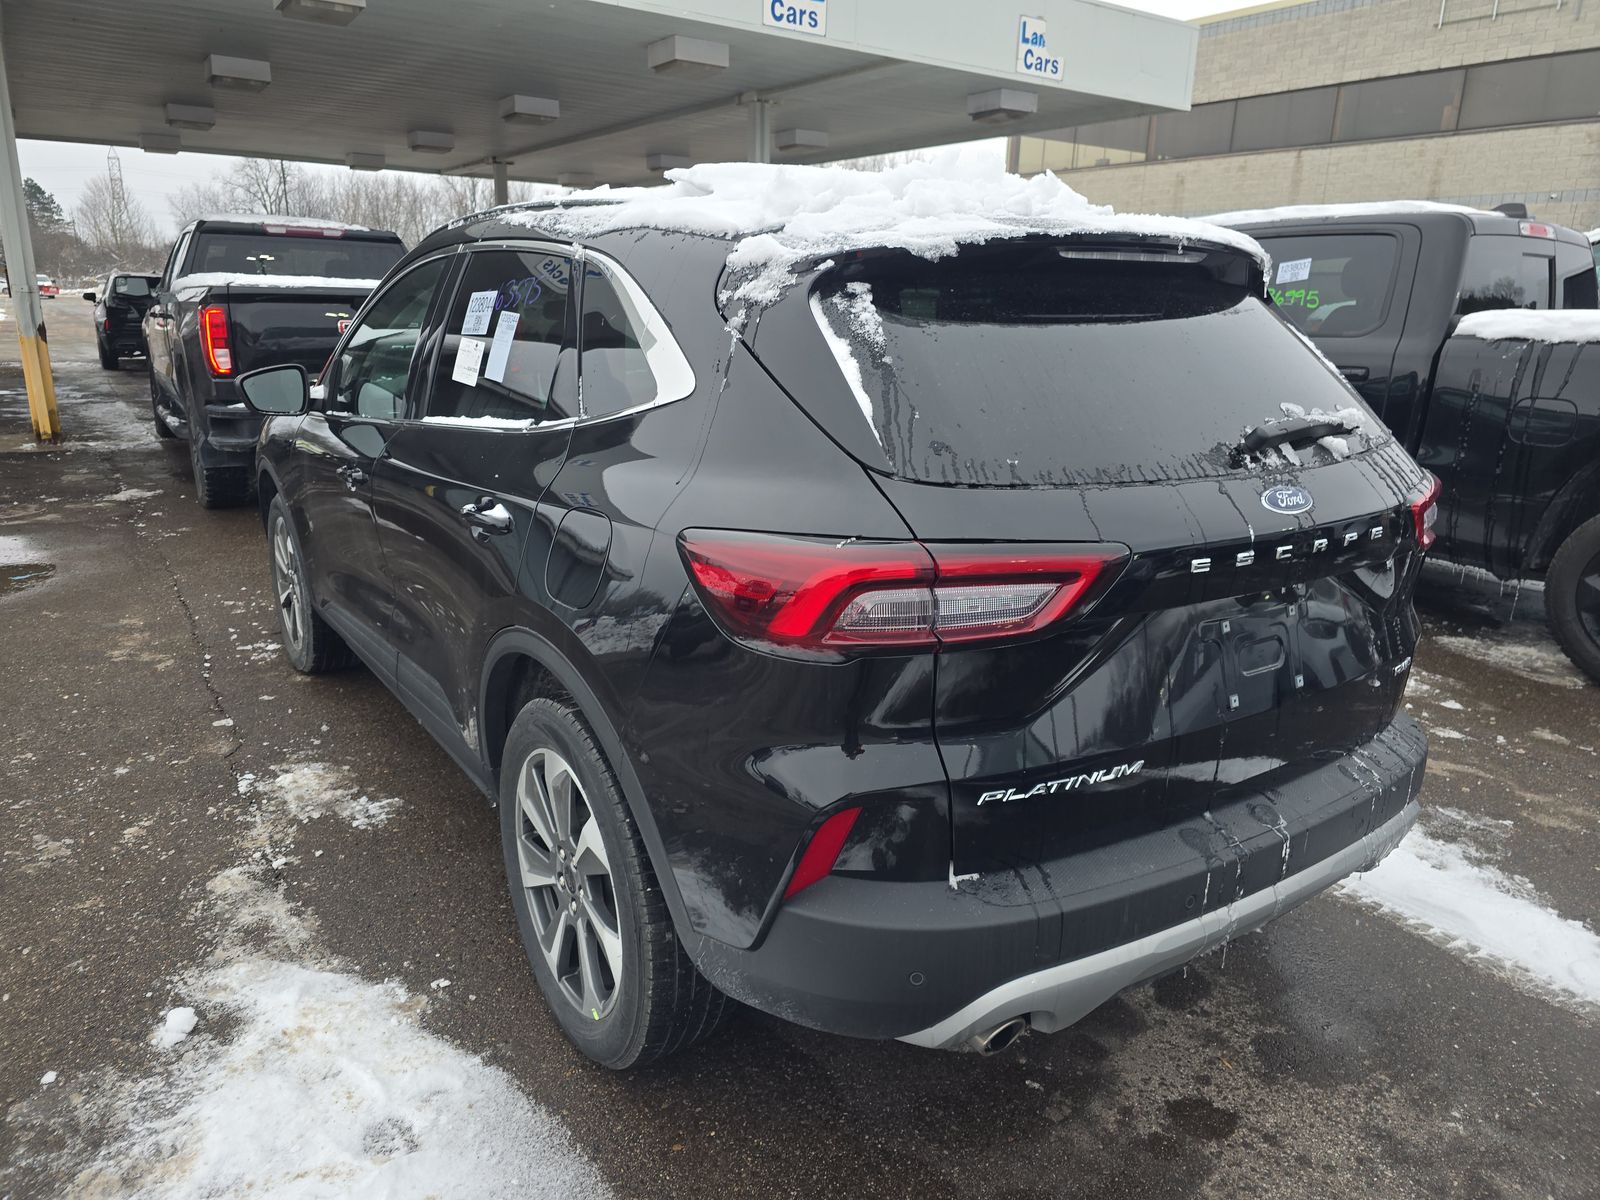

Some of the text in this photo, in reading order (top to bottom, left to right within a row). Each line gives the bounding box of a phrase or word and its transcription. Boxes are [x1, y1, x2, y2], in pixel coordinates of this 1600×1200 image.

[771, 0, 818, 28] Cars
[1024, 48, 1059, 75] Cars
[1276, 490, 1306, 507] Ford
[1190, 526, 1384, 574] ESCAPE
[976, 759, 1145, 806] PLATINUM
